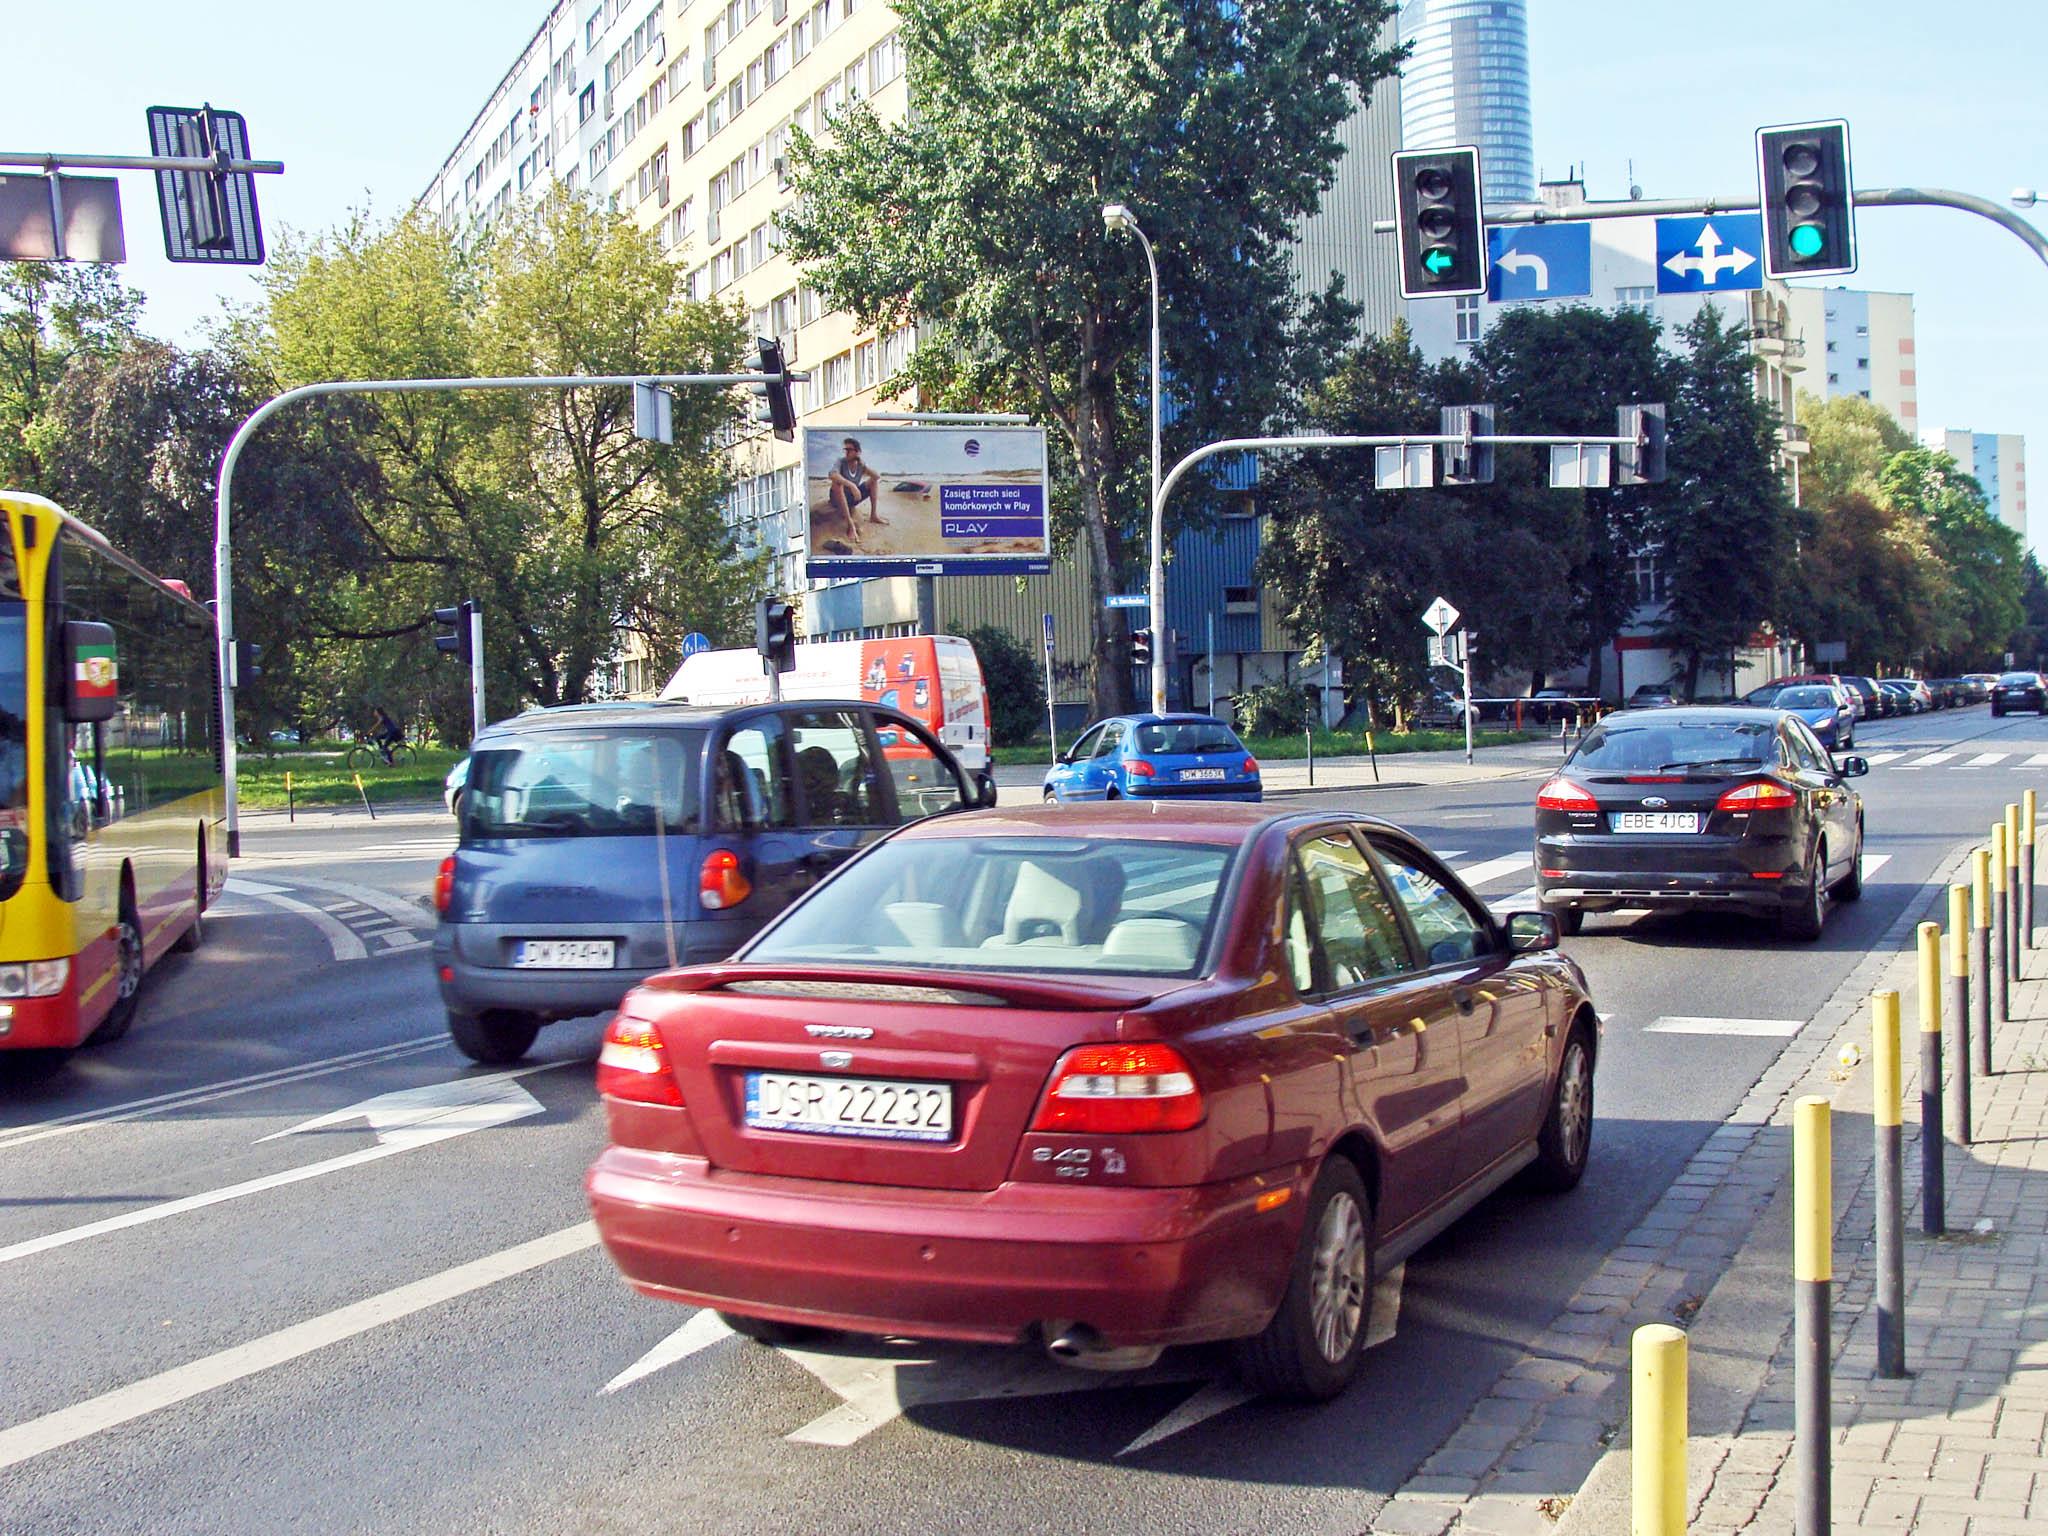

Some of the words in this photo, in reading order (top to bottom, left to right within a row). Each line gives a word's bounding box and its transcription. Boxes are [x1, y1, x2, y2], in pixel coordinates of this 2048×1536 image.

[944, 489, 971, 500] Zasięg
[972, 489, 999, 498] trzech
[1001, 489, 1020, 498] sieci
[945, 501, 1002, 512] komórkowych
[1013, 501, 1031, 512] Play
[945, 523, 988, 533] PLAY
[1623, 814, 1655, 829] EBE
[1659, 813, 1696, 829] 4JC3
[763, 1079, 826, 1121] DSR
[838, 1084, 944, 1128] 22232
